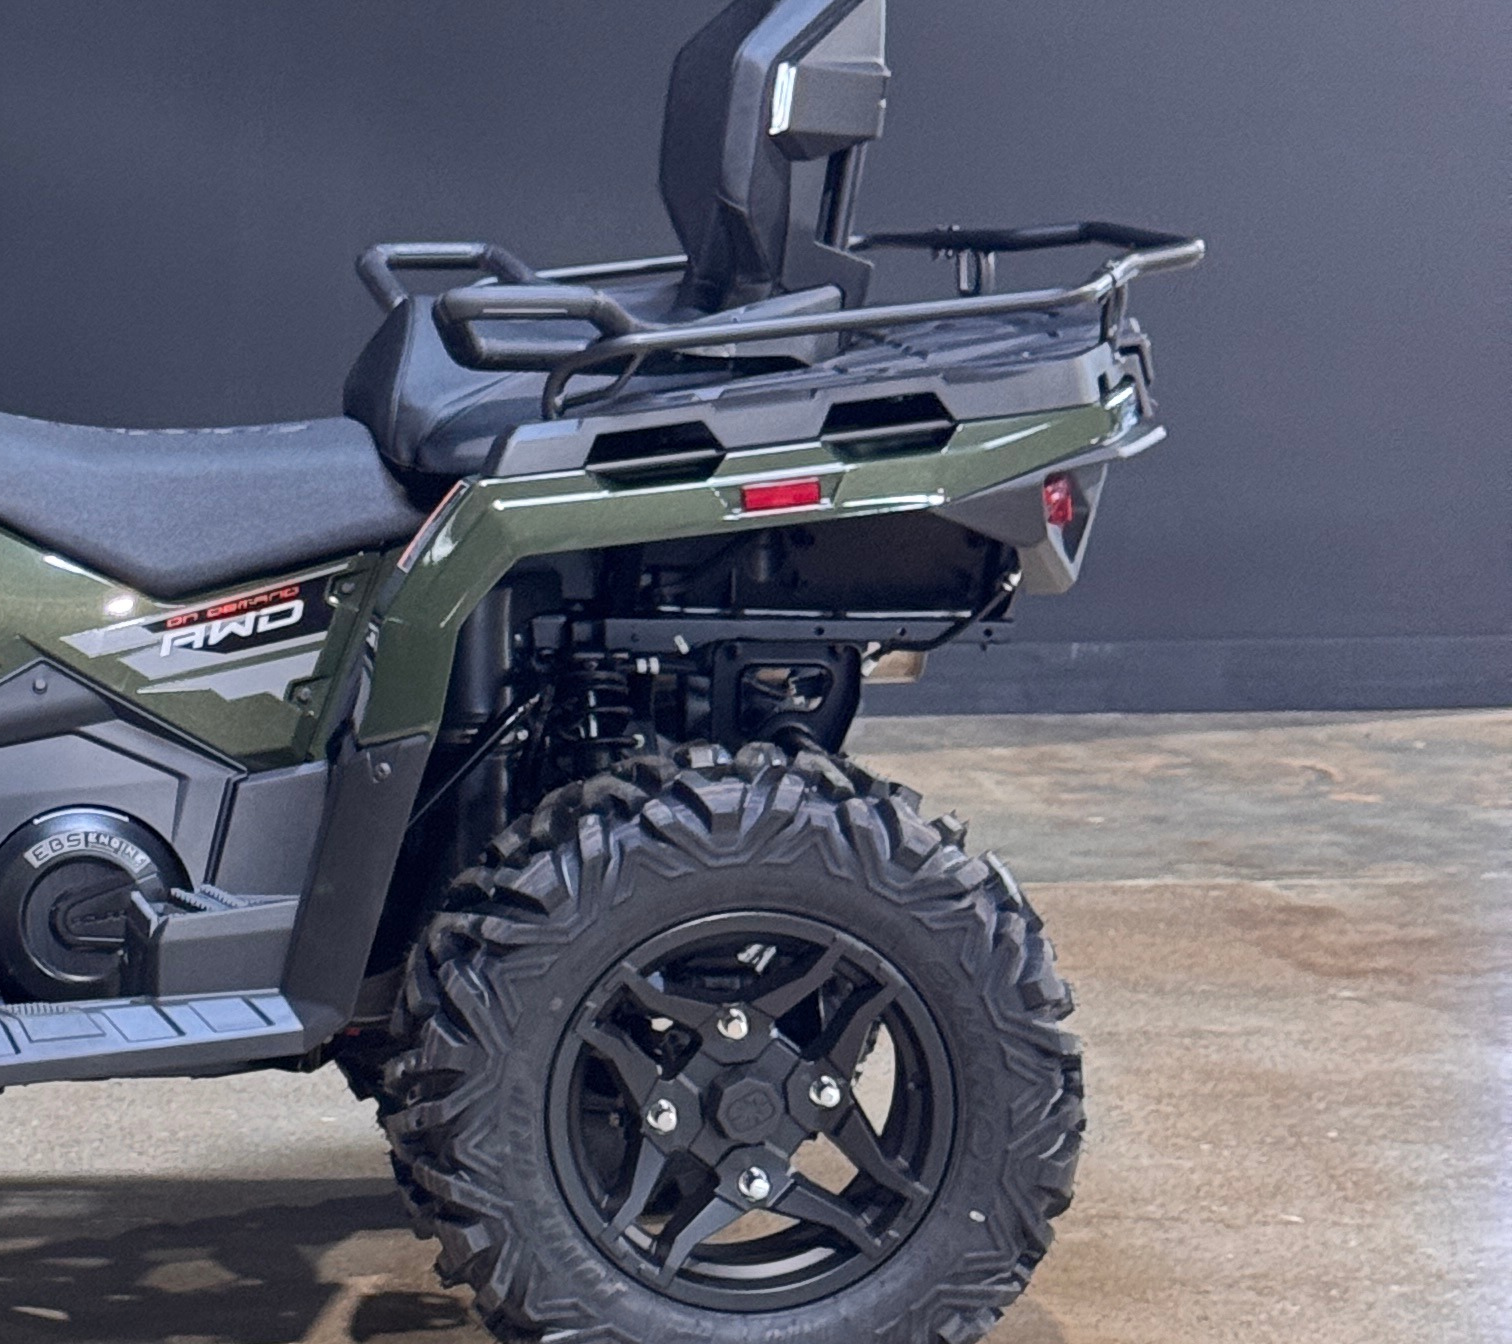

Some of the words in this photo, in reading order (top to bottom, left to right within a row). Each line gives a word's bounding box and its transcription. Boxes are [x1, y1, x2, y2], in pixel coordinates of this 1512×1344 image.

[160, 599, 304, 657] AWD
[166, 613, 199, 628] ON
[32, 833, 82, 862] EBS
